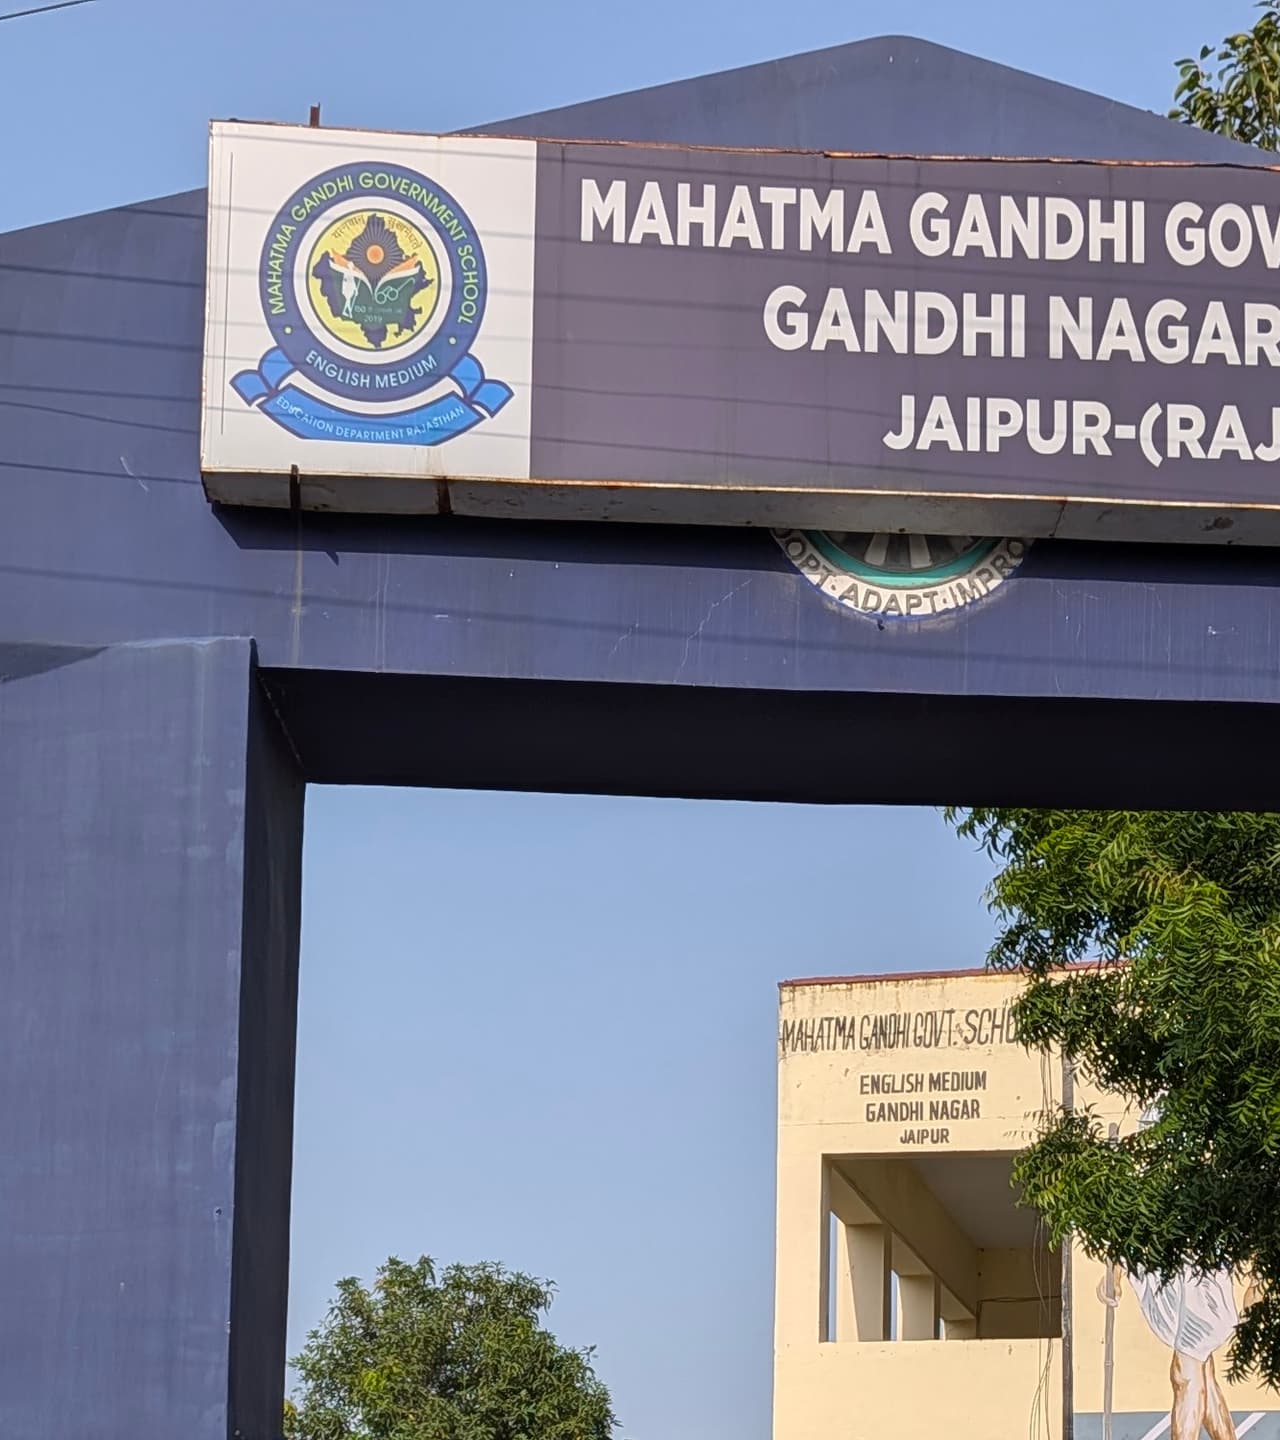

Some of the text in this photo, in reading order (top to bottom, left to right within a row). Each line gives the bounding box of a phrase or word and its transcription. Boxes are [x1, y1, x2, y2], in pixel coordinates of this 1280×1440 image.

[580, 179, 892, 255] MAHATMA
[909, 192, 1145, 264] GANDHI
[267, 171, 479, 324] MAHATMA GANDHI GOVERNMENT SCHOOL
[763, 285, 1026, 359] GANDHI
[305, 350, 438, 389] ENGLISH MEDIUM
[335, 405, 465, 441] DEPARTMENT RAJASTHAN
[839, 582, 938, 616] ADAPT
[780, 1012, 911, 1051] MAHATMA GANDHI
[860, 1070, 987, 1095] ENGLISH MEDIUM
[866, 1099, 981, 1122] GANDHI NAGAR
[900, 1128, 950, 1144] JAIPUR
